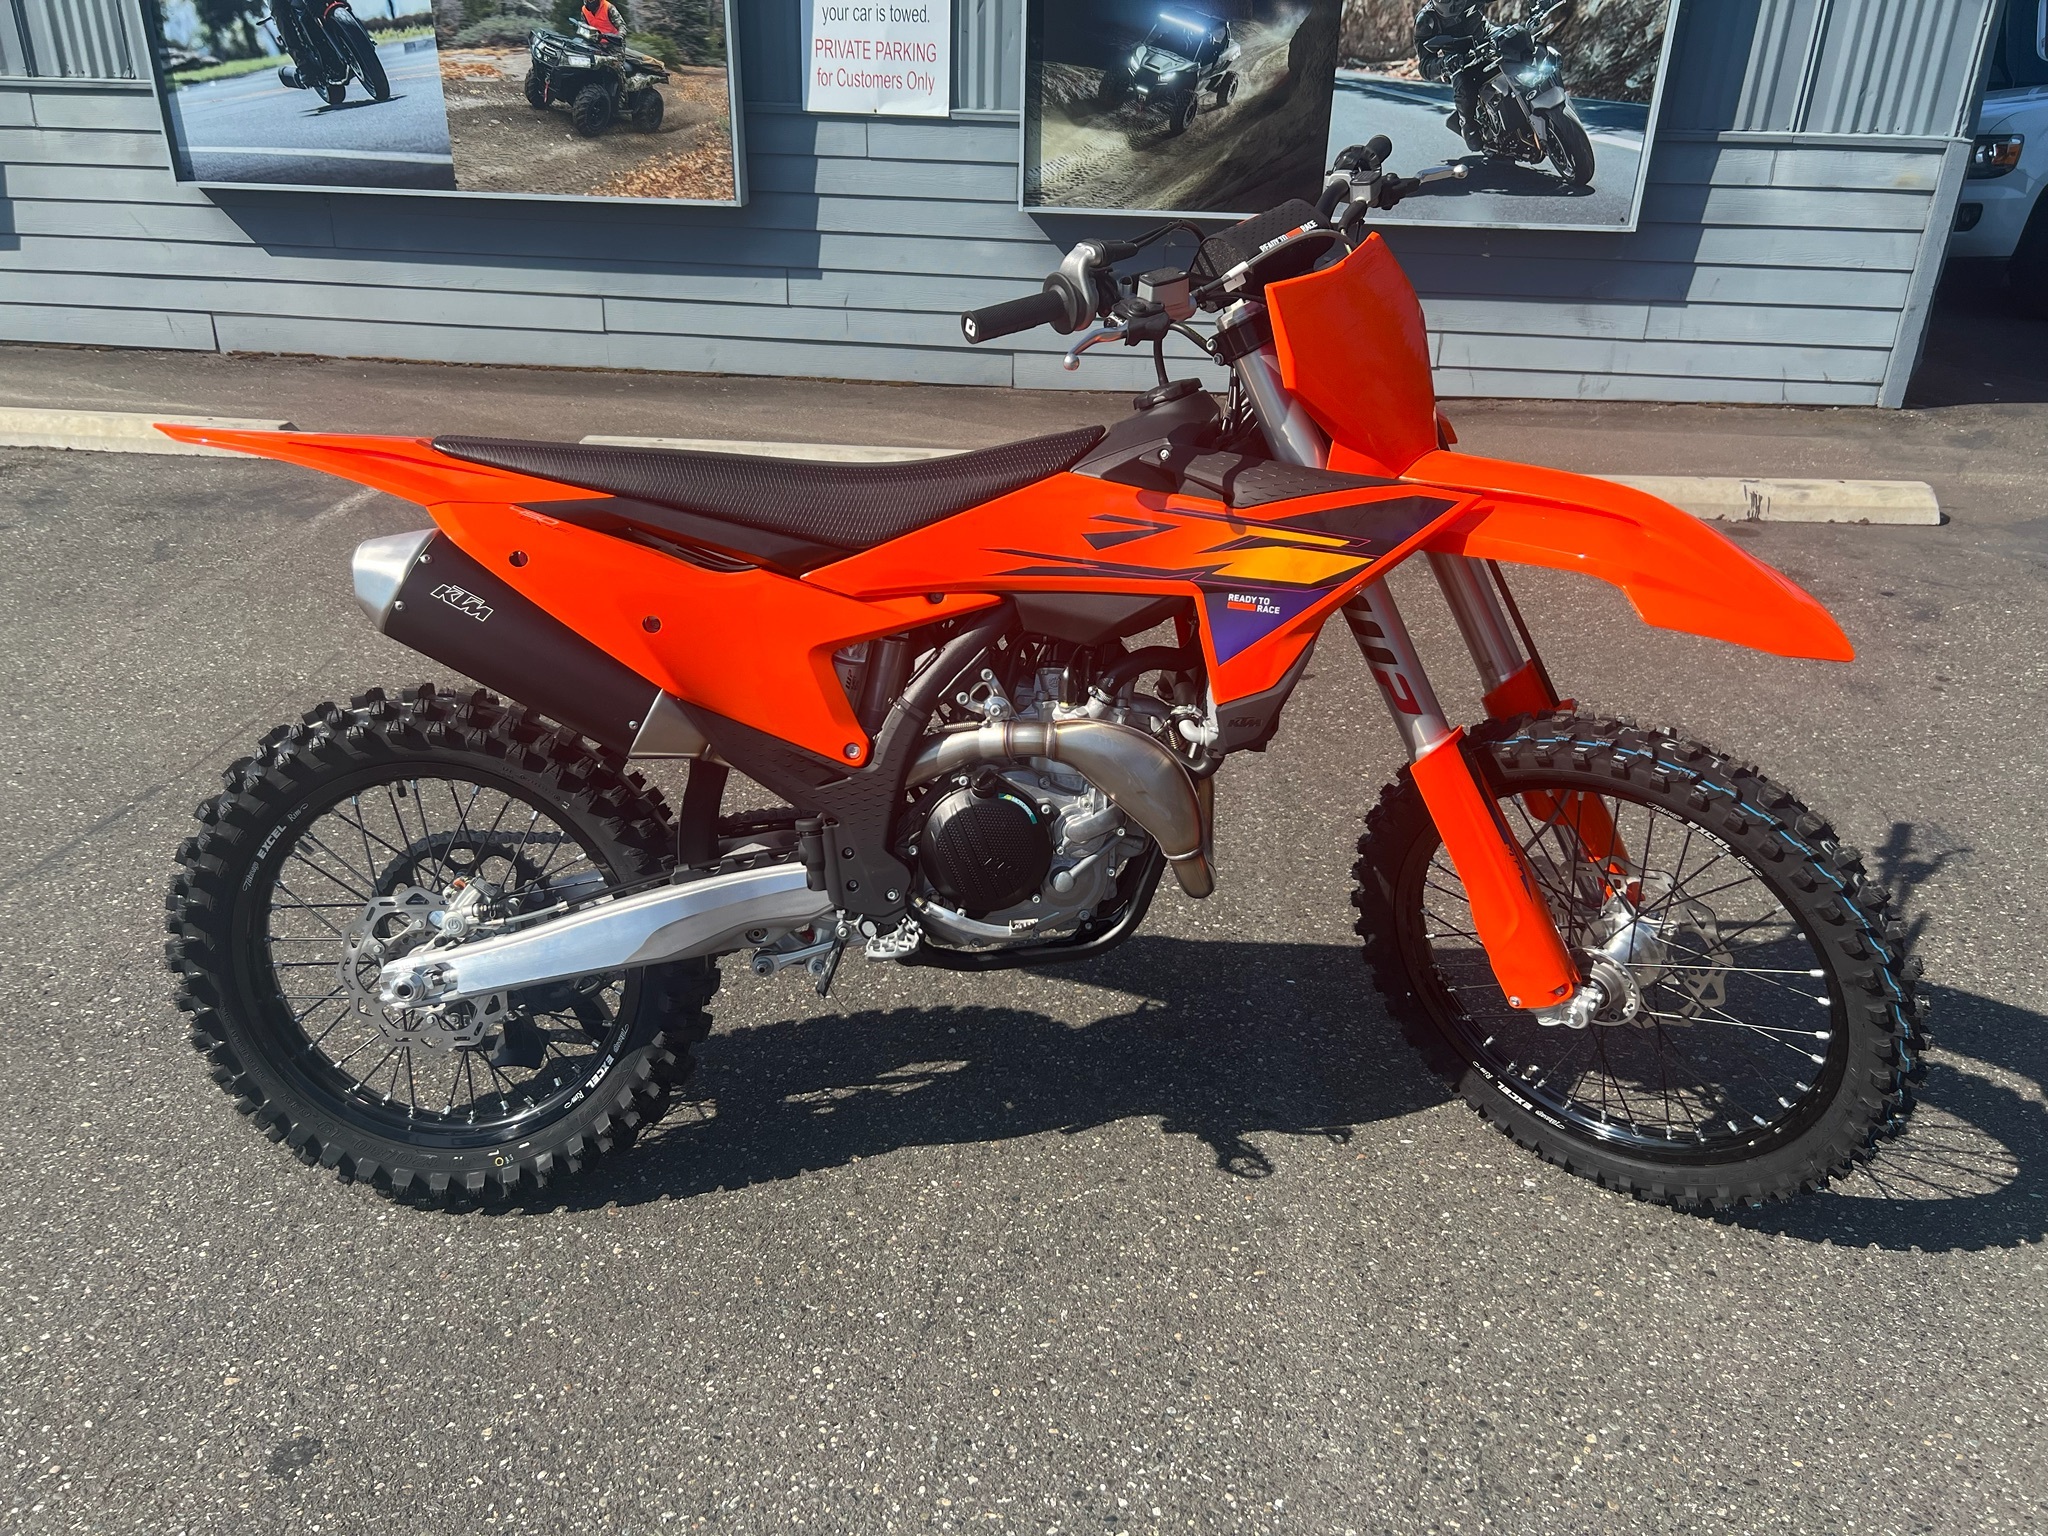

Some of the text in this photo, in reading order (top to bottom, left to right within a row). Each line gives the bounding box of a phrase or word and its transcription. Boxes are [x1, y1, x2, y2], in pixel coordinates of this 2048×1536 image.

[822, 4, 930, 25] your car is towed.
[815, 39, 937, 62] PRIVATE PARKING
[817, 67, 935, 95] for Customers Only
[1300, 220, 1318, 232] RACE
[430, 583, 494, 622] KTM
[1228, 593, 1270, 605] READY TO
[1256, 605, 1280, 614] RACE
[1227, 716, 1262, 728] KTM
[257, 825, 287, 860] EXCEL
[287, 803, 309, 822] Rim
[1686, 820, 1732, 853] EXCEL
[586, 1054, 615, 1089] EXCEL
[1497, 1080, 1534, 1111] EXCEL
